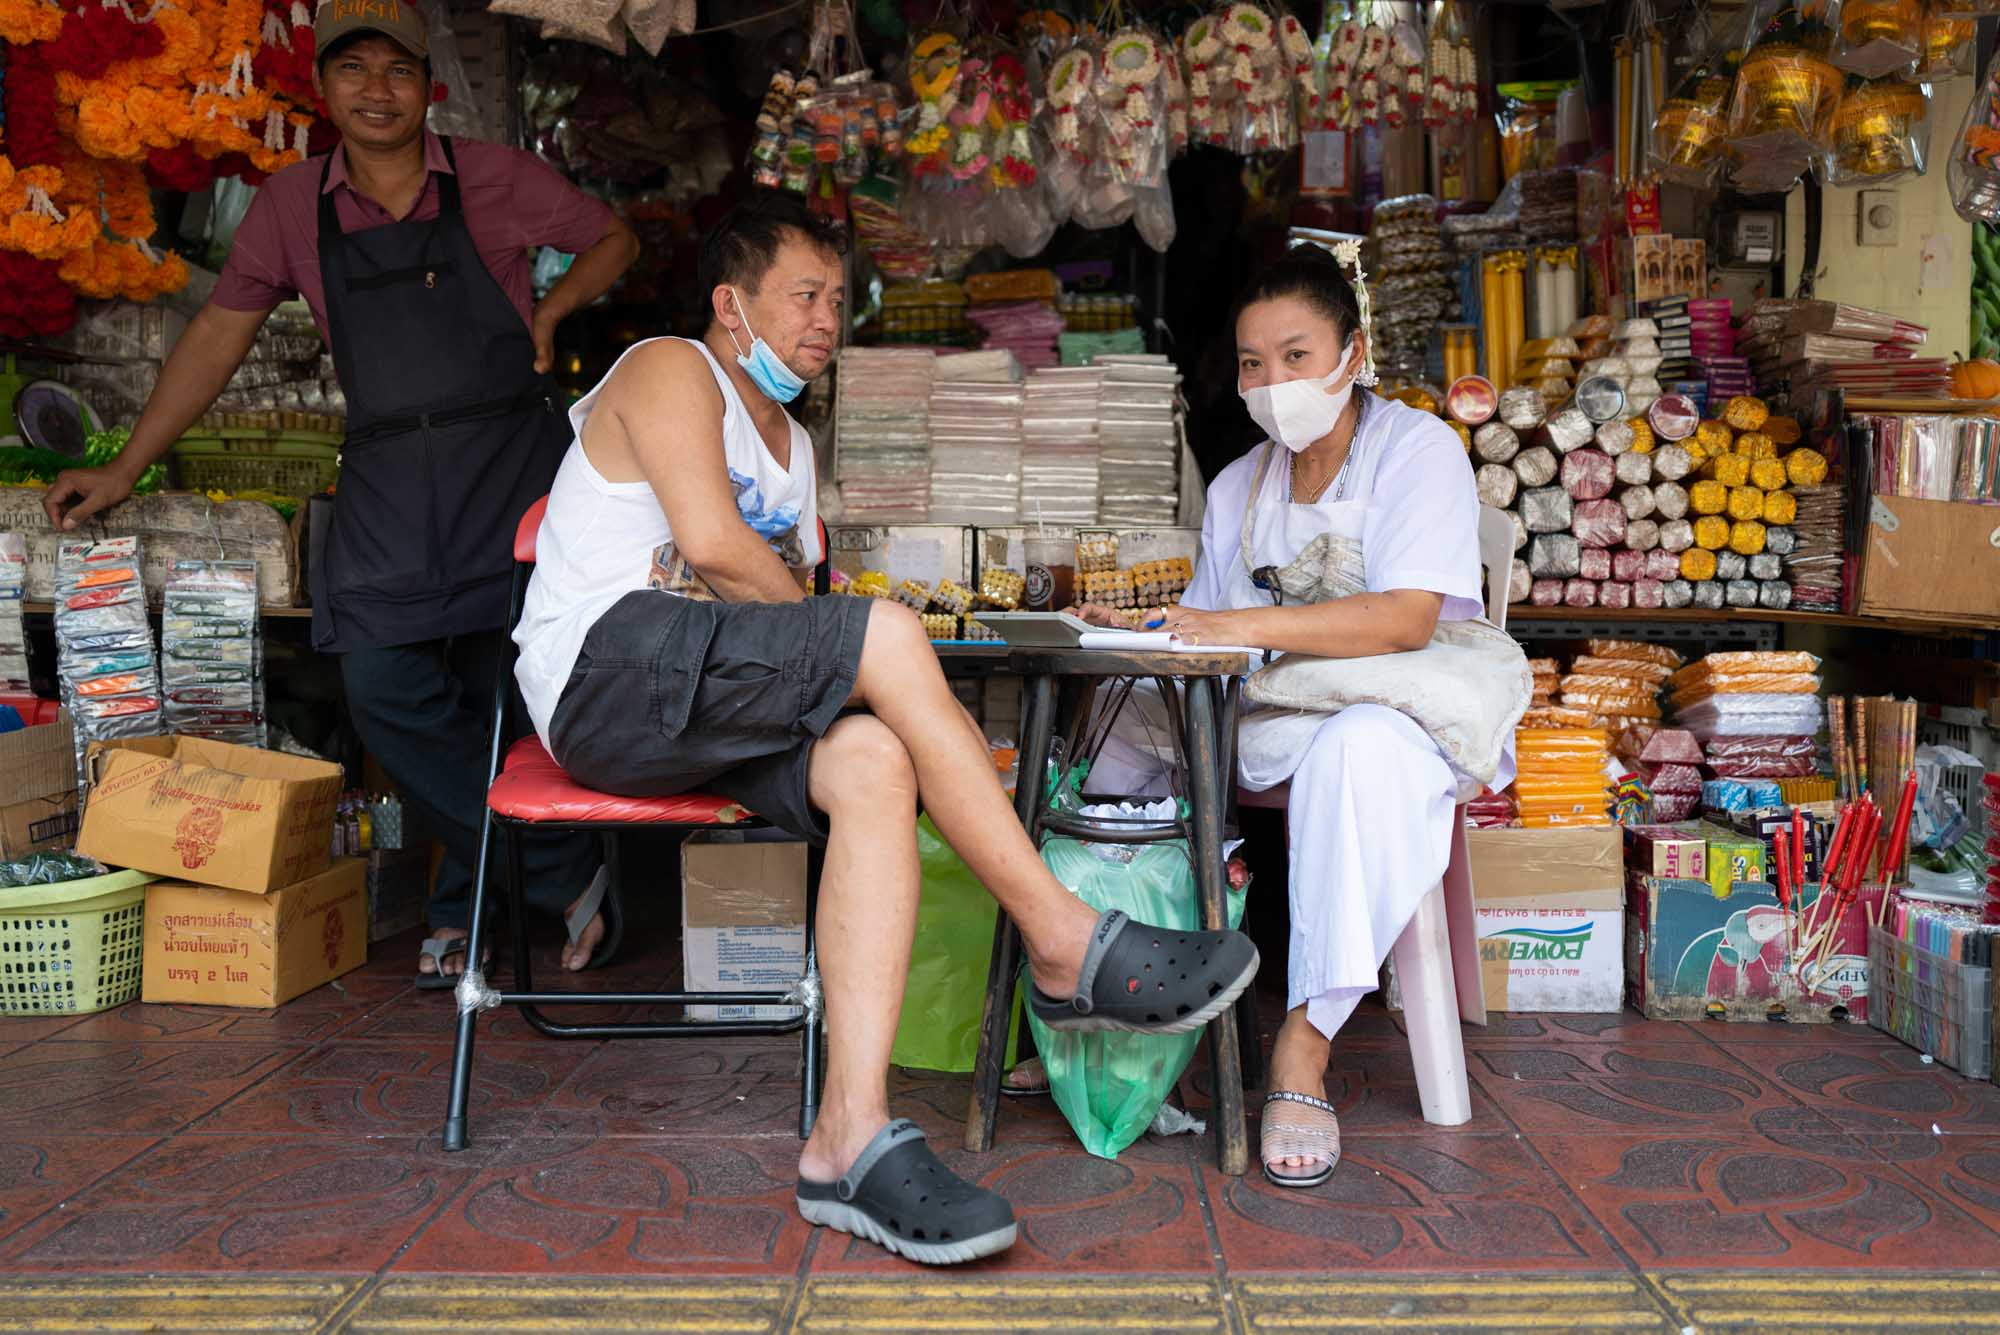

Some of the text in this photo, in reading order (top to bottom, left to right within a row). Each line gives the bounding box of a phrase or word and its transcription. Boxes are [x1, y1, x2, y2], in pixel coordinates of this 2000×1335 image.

[167, 964, 249, 985] บรรจุ 2 โหล
